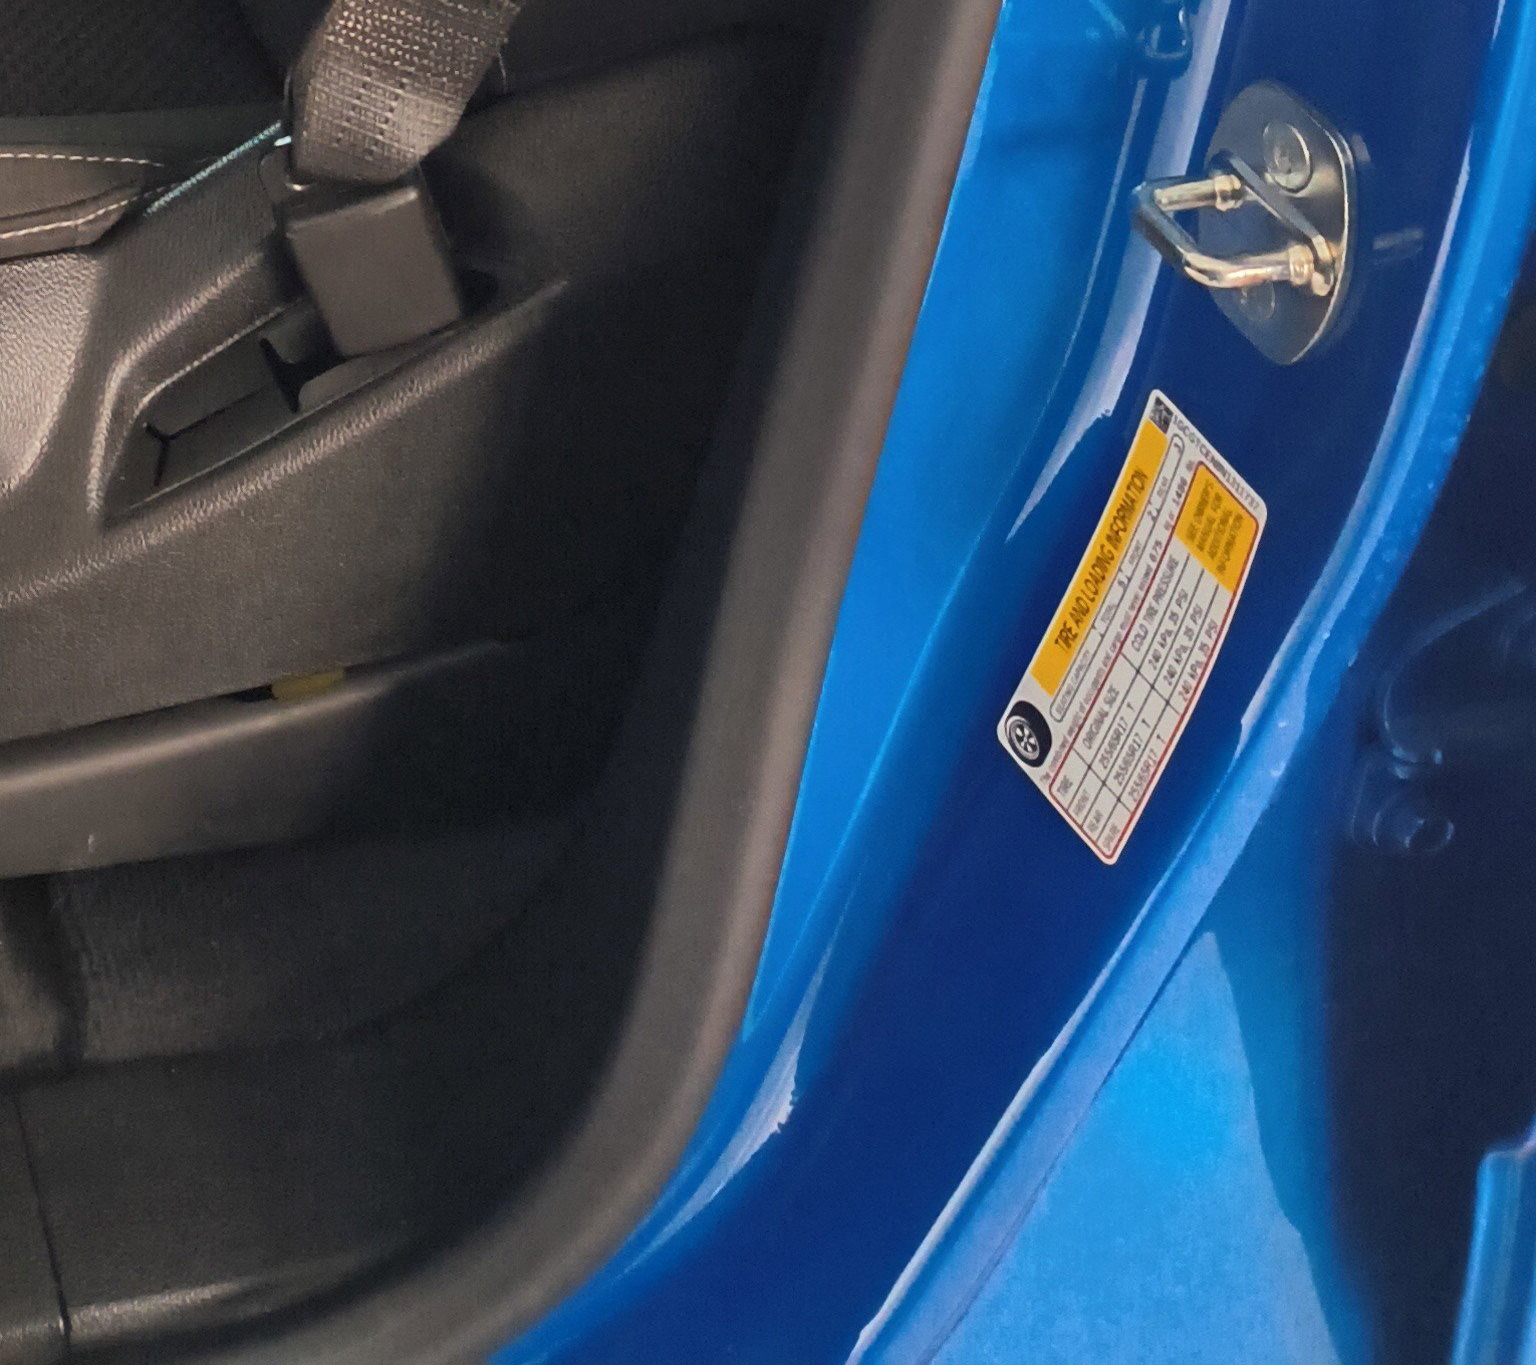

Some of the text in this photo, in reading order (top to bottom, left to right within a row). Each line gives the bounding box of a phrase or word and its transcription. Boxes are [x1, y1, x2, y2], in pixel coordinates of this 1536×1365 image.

[1053, 463, 1149, 657] TIRE AND LOADING INFORMATION
[1129, 552, 1180, 654] COLD TIRE PRESSURE
[1147, 646, 1163, 672] 240
[1167, 607, 1180, 626] 35
[1174, 586, 1189, 610] PSI
[1162, 662, 1177, 687] 240
[1182, 623, 1195, 642] 35
[1189, 601, 1204, 626] PSI
[1177, 677, 1193, 703] 240
[1197, 638, 1209, 657] 35
[1203, 617, 1218, 641] PSI
[1081, 682, 1120, 751] ORIGINAL SIZE
